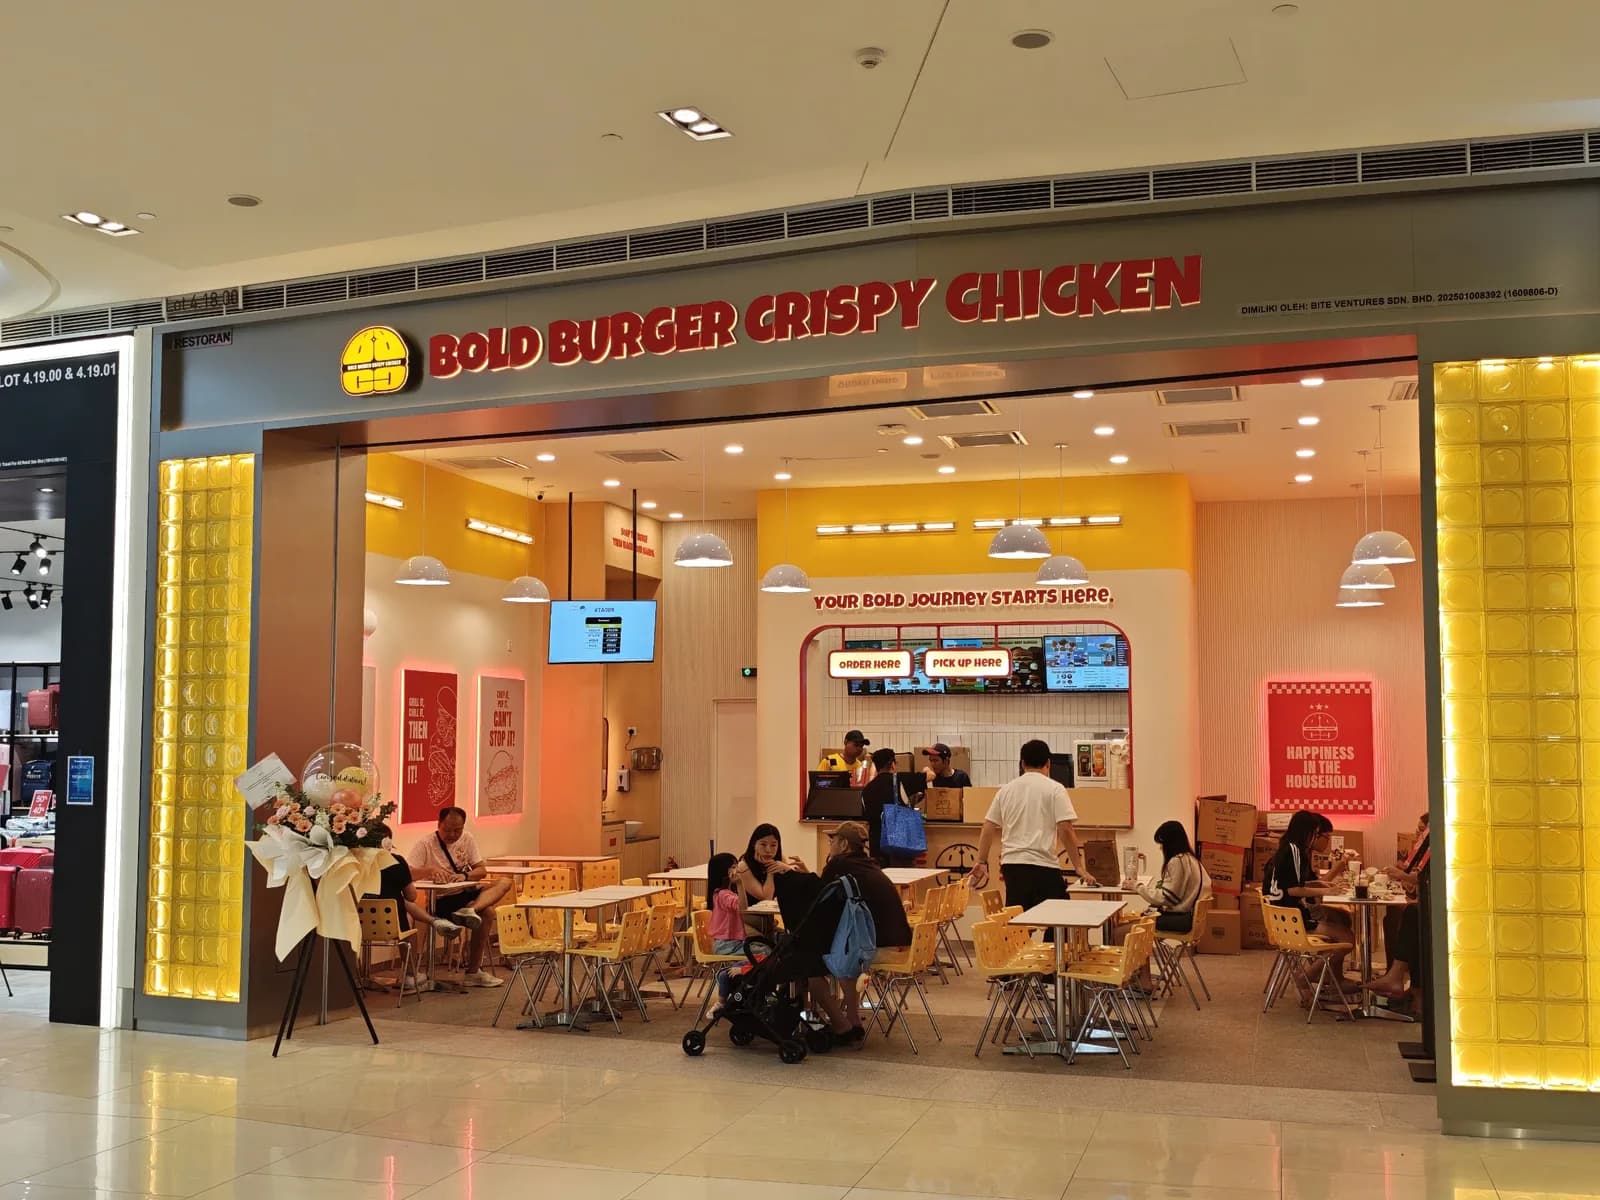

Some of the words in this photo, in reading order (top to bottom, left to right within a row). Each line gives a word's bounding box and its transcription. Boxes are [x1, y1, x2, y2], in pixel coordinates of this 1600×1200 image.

[1241, 304, 1278, 315] DIMILIKI
[1280, 302, 1308, 312] OLEH:
[1311, 300, 1331, 310] BITE
[1334, 297, 1385, 308] VENTURES
[428, 323, 544, 380] BOLD
[548, 300, 738, 368] BURGER
[744, 277, 937, 344] CRISPY
[945, 255, 1203, 323] CHICKEN
[173, 330, 231, 350] RESTORAN
[23, 368, 62, 385] 4.19.00
[65, 366, 74, 380] &
[76, 361, 117, 379] 4.19.01
[813, 593, 859, 610] YOUR
[862, 592, 905, 608] BOLD
[991, 588, 1058, 605] STARTS
[839, 660, 871, 669] ORDER
[933, 658, 956, 668] PICK
[958, 658, 972, 668] UP
[408, 721, 428, 739] THEN
[489, 730, 505, 747] STOP
[408, 743, 425, 762] KILL
[1286, 745, 1355, 760] HAPPINESS
[407, 765, 418, 784] IT!
[1303, 760, 1316, 774] IN
[1319, 760, 1341, 774] THE
[1285, 774, 1357, 789] HOUSEHOLD
